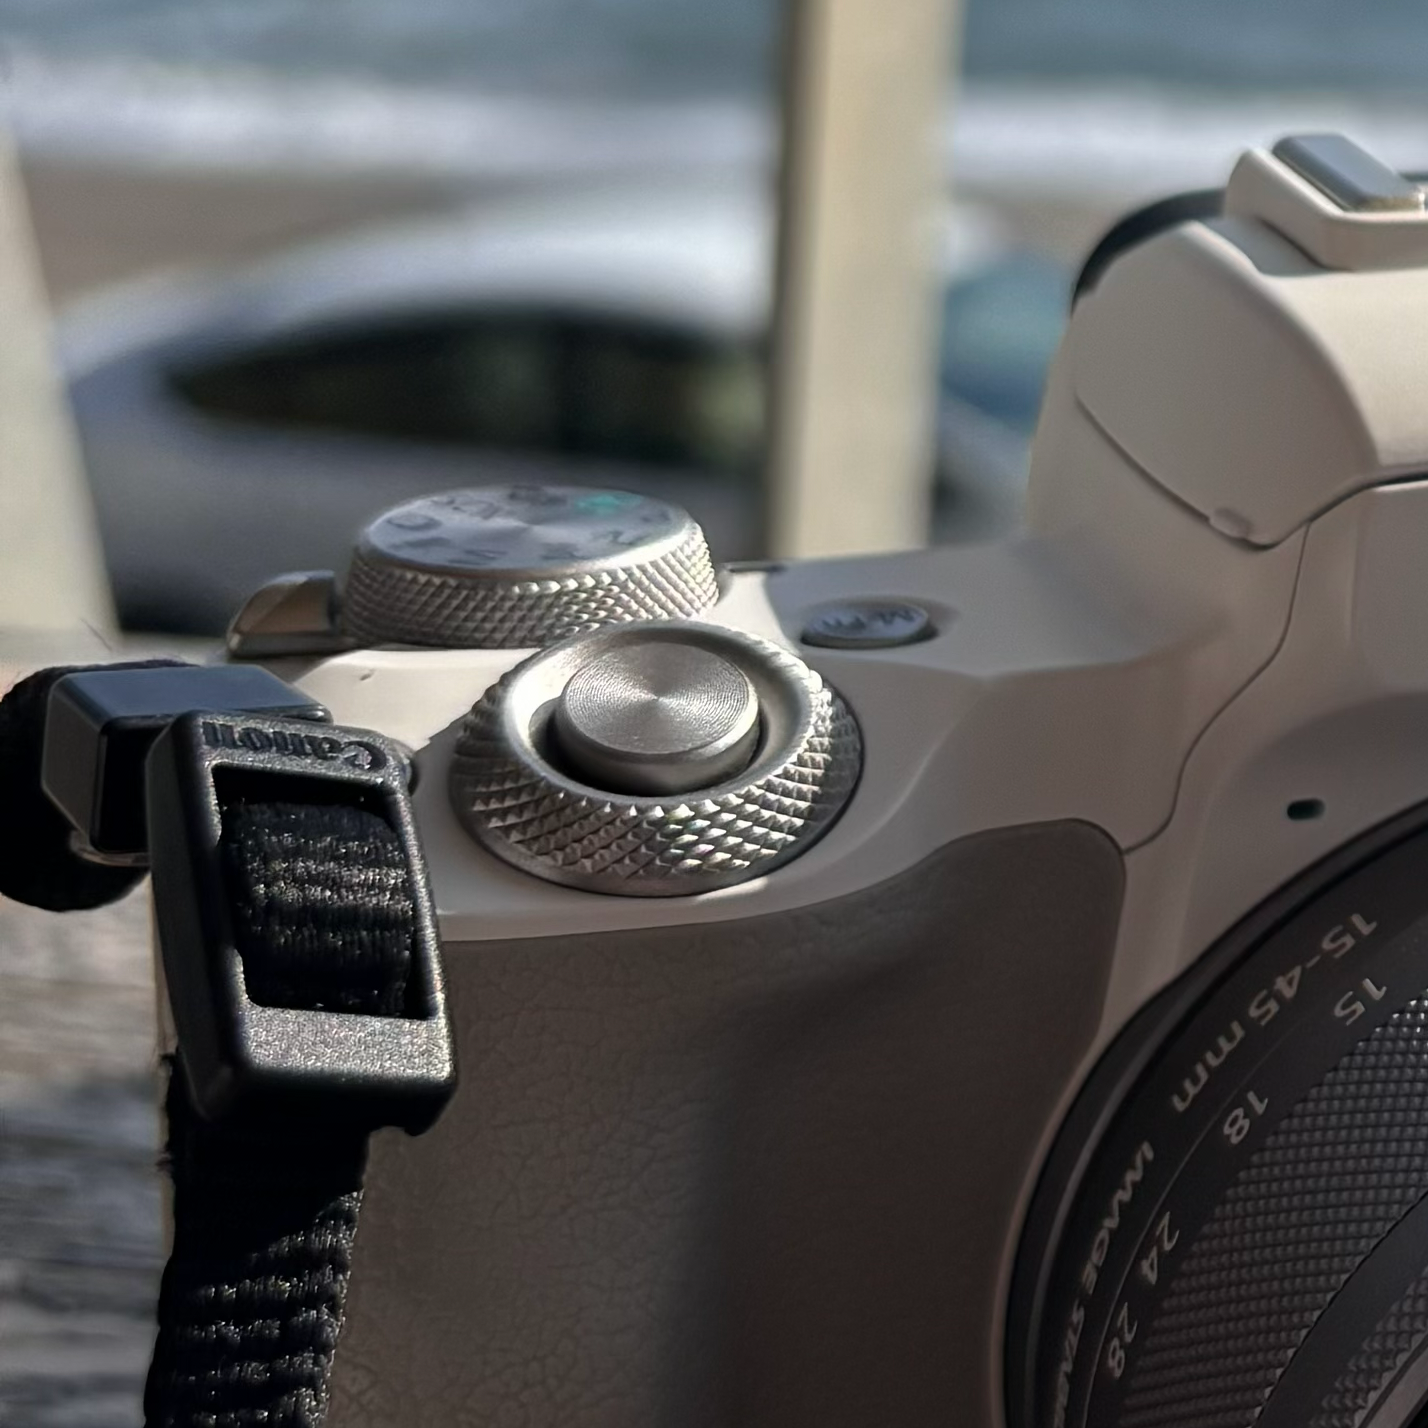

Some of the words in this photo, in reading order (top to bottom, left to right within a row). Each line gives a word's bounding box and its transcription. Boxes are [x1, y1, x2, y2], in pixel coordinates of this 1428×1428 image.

[202, 722, 387, 770] Canon
[1334, 977, 1387, 1026] 15
[1223, 1090, 1268, 1144] 18
[1141, 1210, 1180, 1285] 24
[1108, 1302, 1138, 1379] 28
